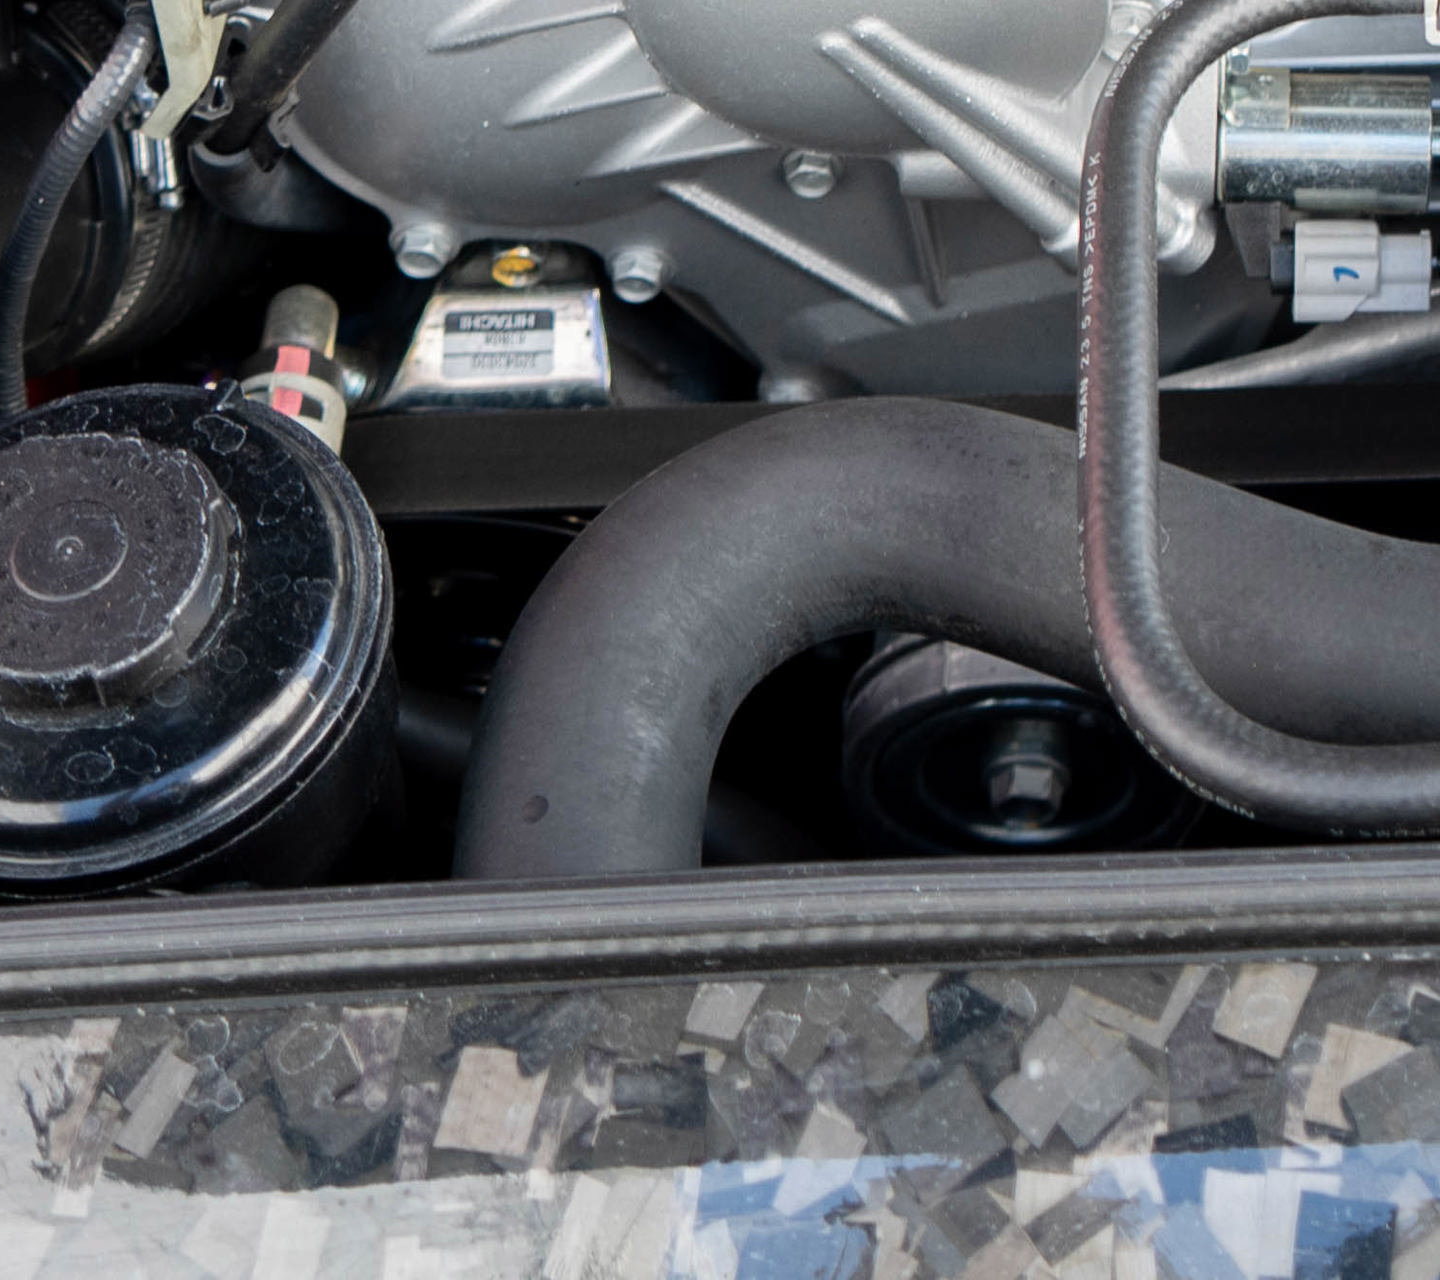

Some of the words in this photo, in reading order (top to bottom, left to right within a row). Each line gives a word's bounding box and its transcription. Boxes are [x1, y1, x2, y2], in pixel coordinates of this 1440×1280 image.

[1089, 151, 1101, 166] K
[1082, 263, 1094, 306] TNS
[459, 314, 536, 329] HITACHI
[1078, 377, 1089, 459] NISSAN
